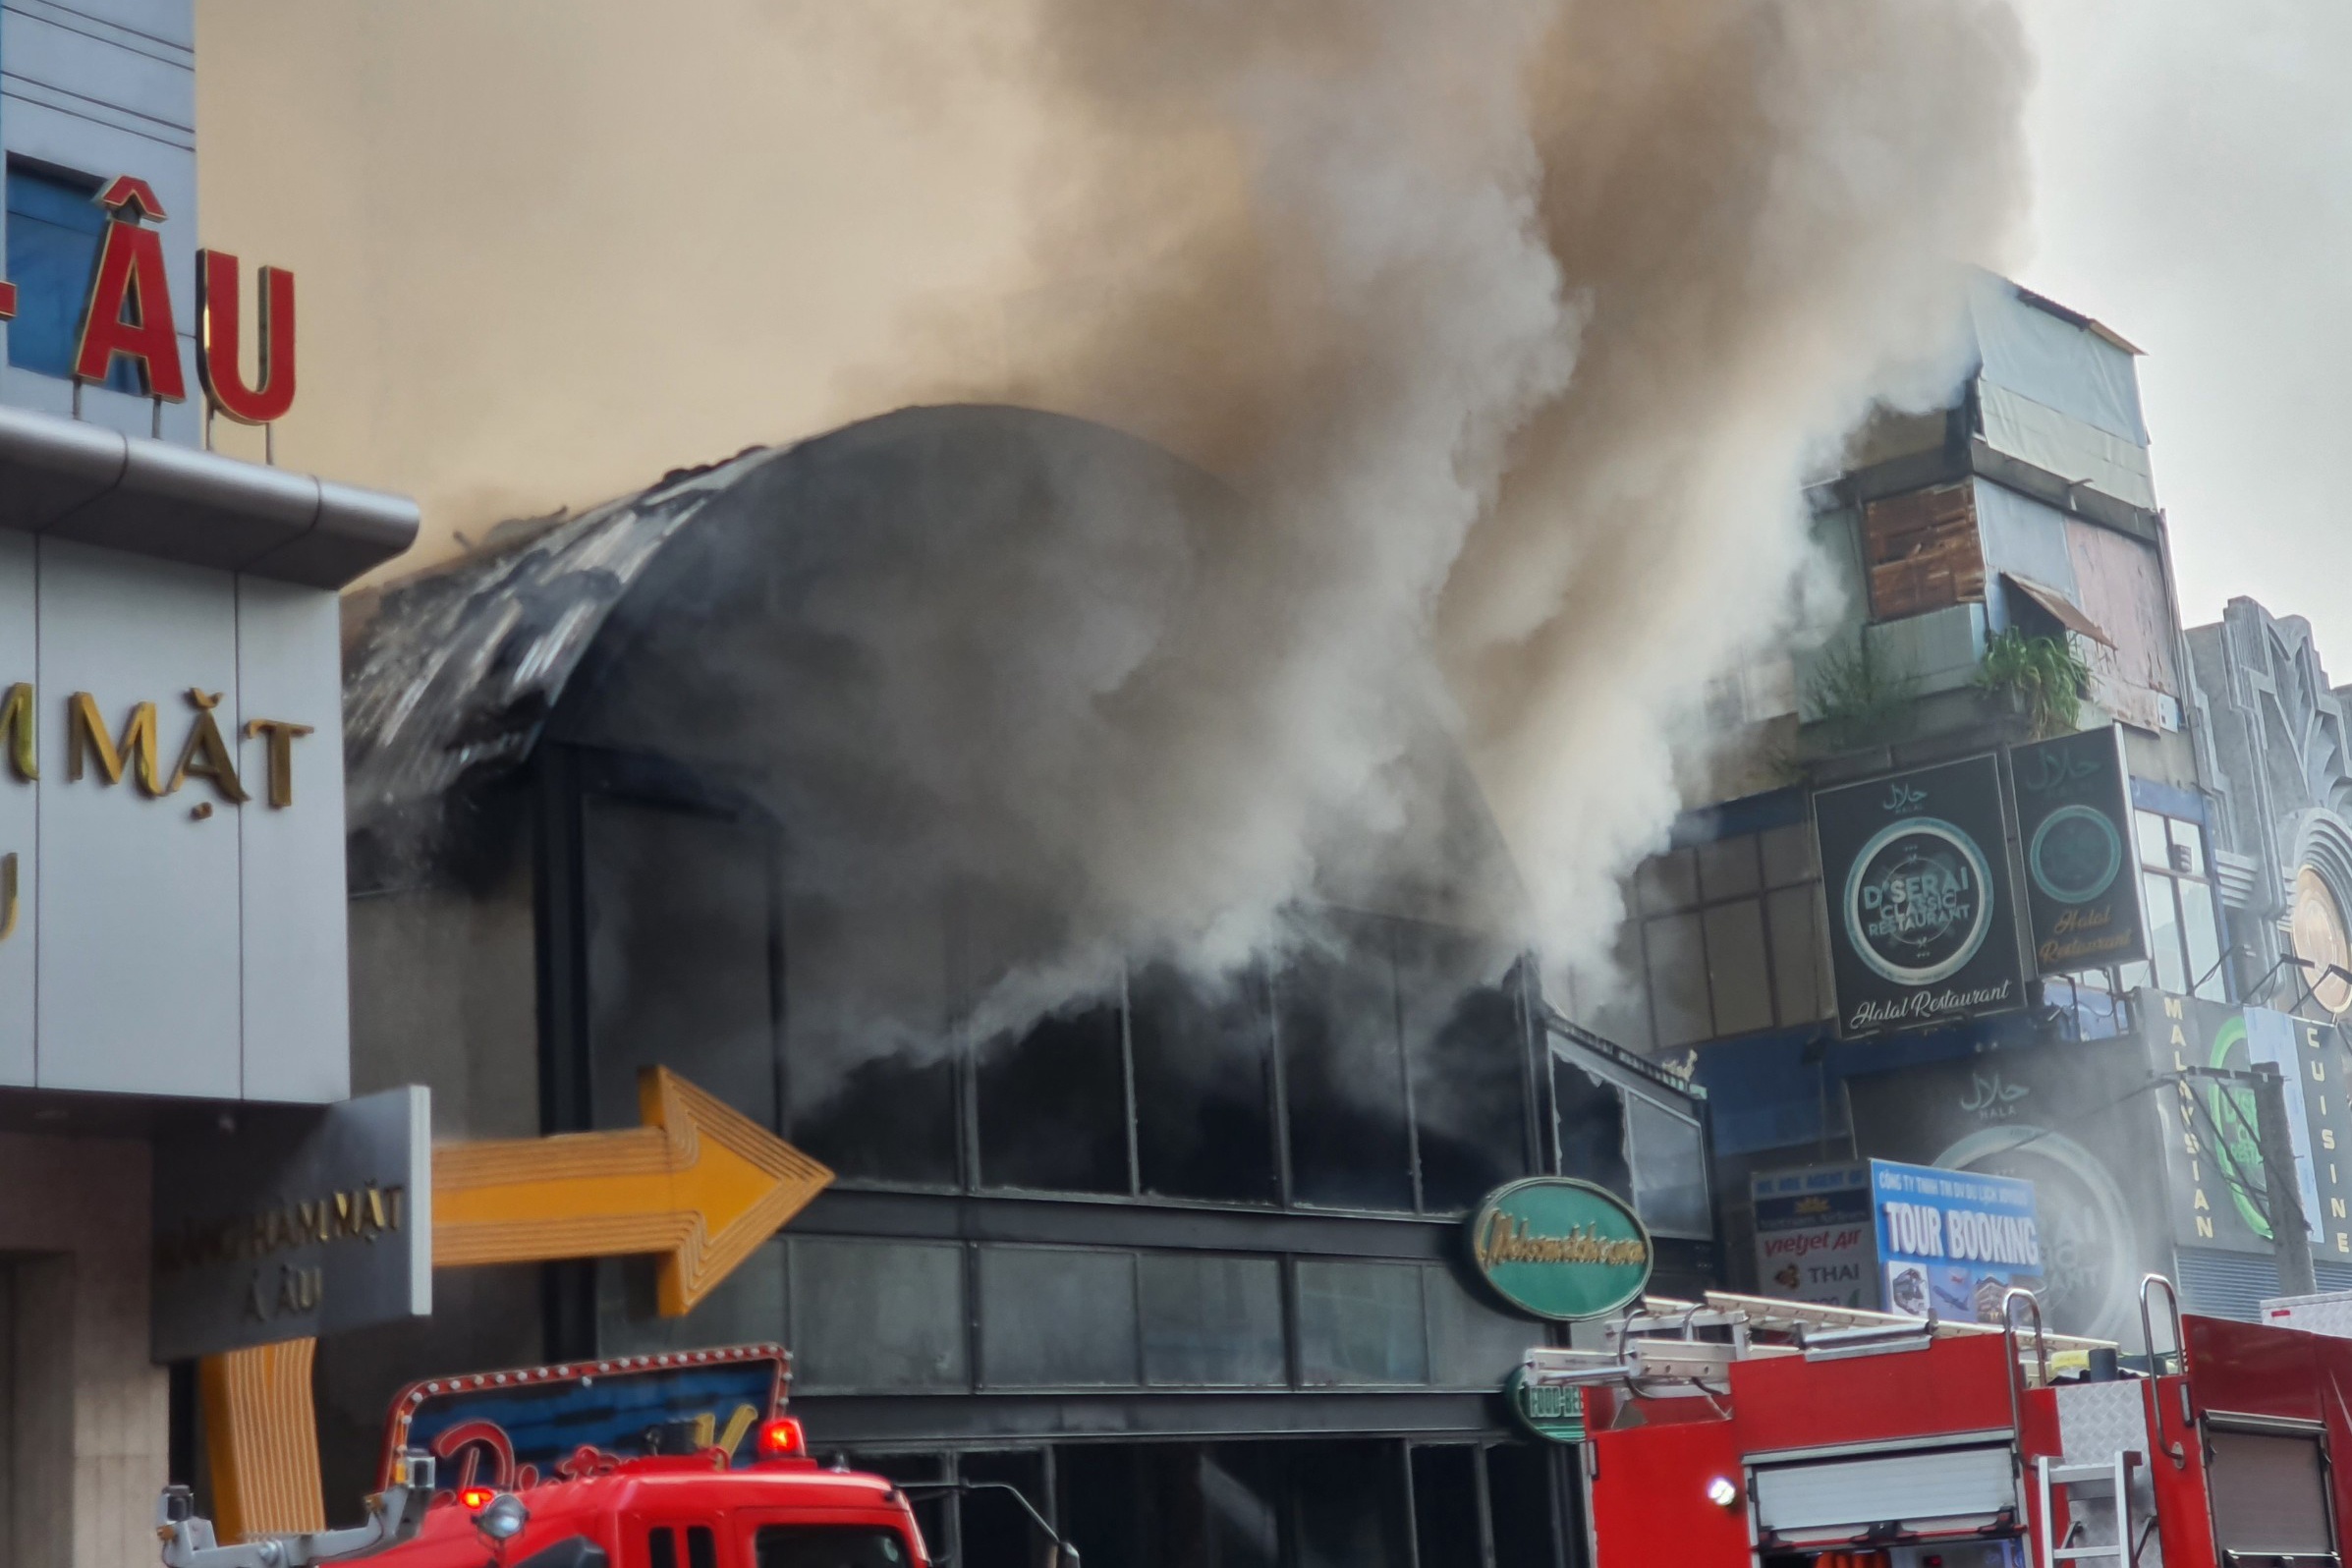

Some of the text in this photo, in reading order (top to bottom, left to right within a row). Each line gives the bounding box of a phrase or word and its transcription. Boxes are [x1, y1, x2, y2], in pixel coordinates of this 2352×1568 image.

[67, 686, 314, 820] MẶT
[1869, 904, 1971, 937] RESTAURANT
[1849, 979, 2013, 1030] Halal Restaurant
[2306, 1027, 2351, 1255] CUISINE
[1883, 1201, 1944, 1258] TOUR
[1945, 1208, 2039, 1266] BOOKING
[1809, 1262, 1861, 1284] THAI
